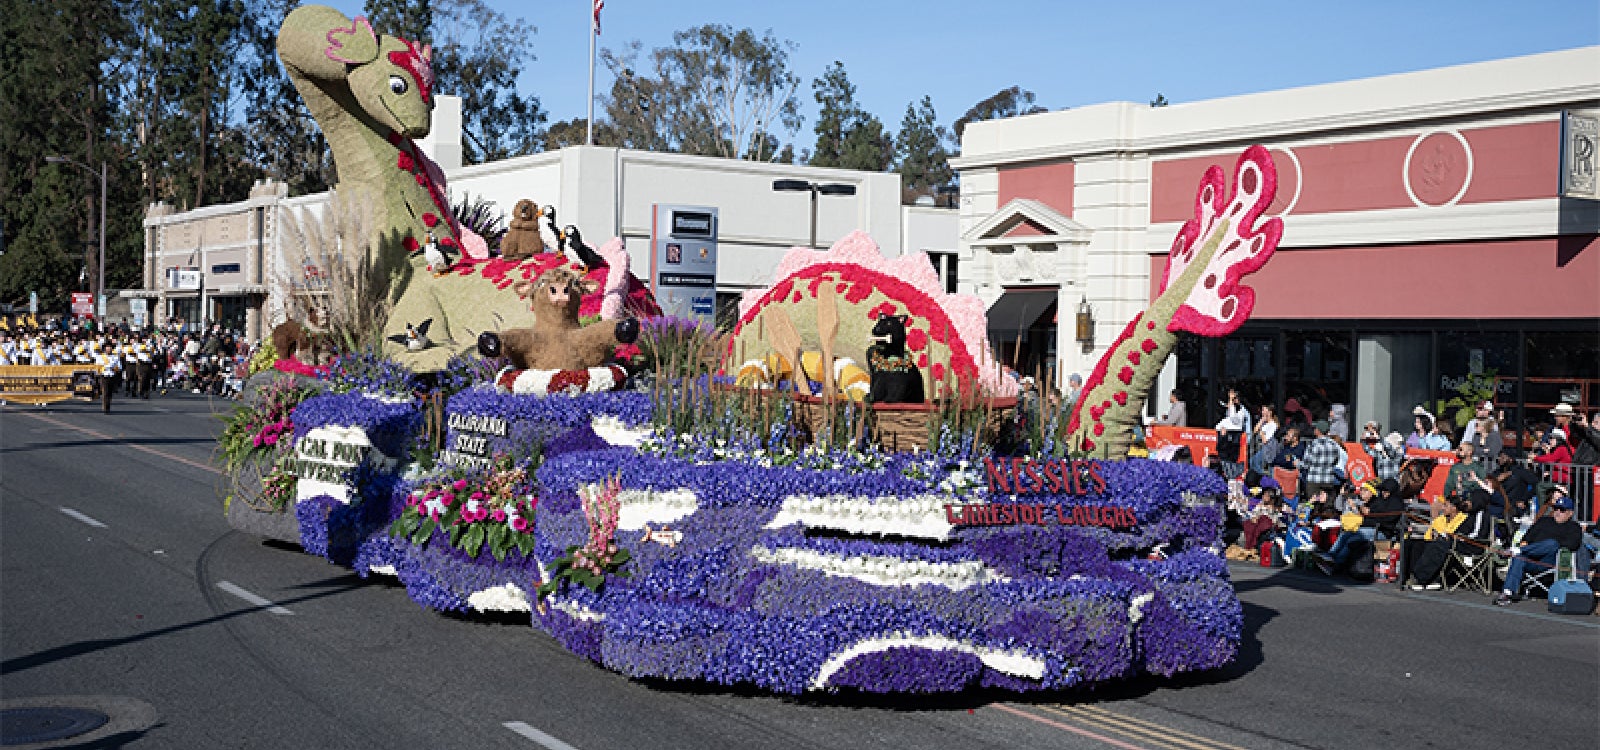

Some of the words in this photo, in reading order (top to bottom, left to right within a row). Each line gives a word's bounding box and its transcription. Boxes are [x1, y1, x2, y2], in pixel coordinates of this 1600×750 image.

[448, 411, 506, 436] CALIFORNIA
[300, 437, 327, 459] CAL
[454, 435, 487, 454] STATE
[944, 503, 1047, 525] LAKESIDE
[1055, 503, 1137, 528] LAUGHS
